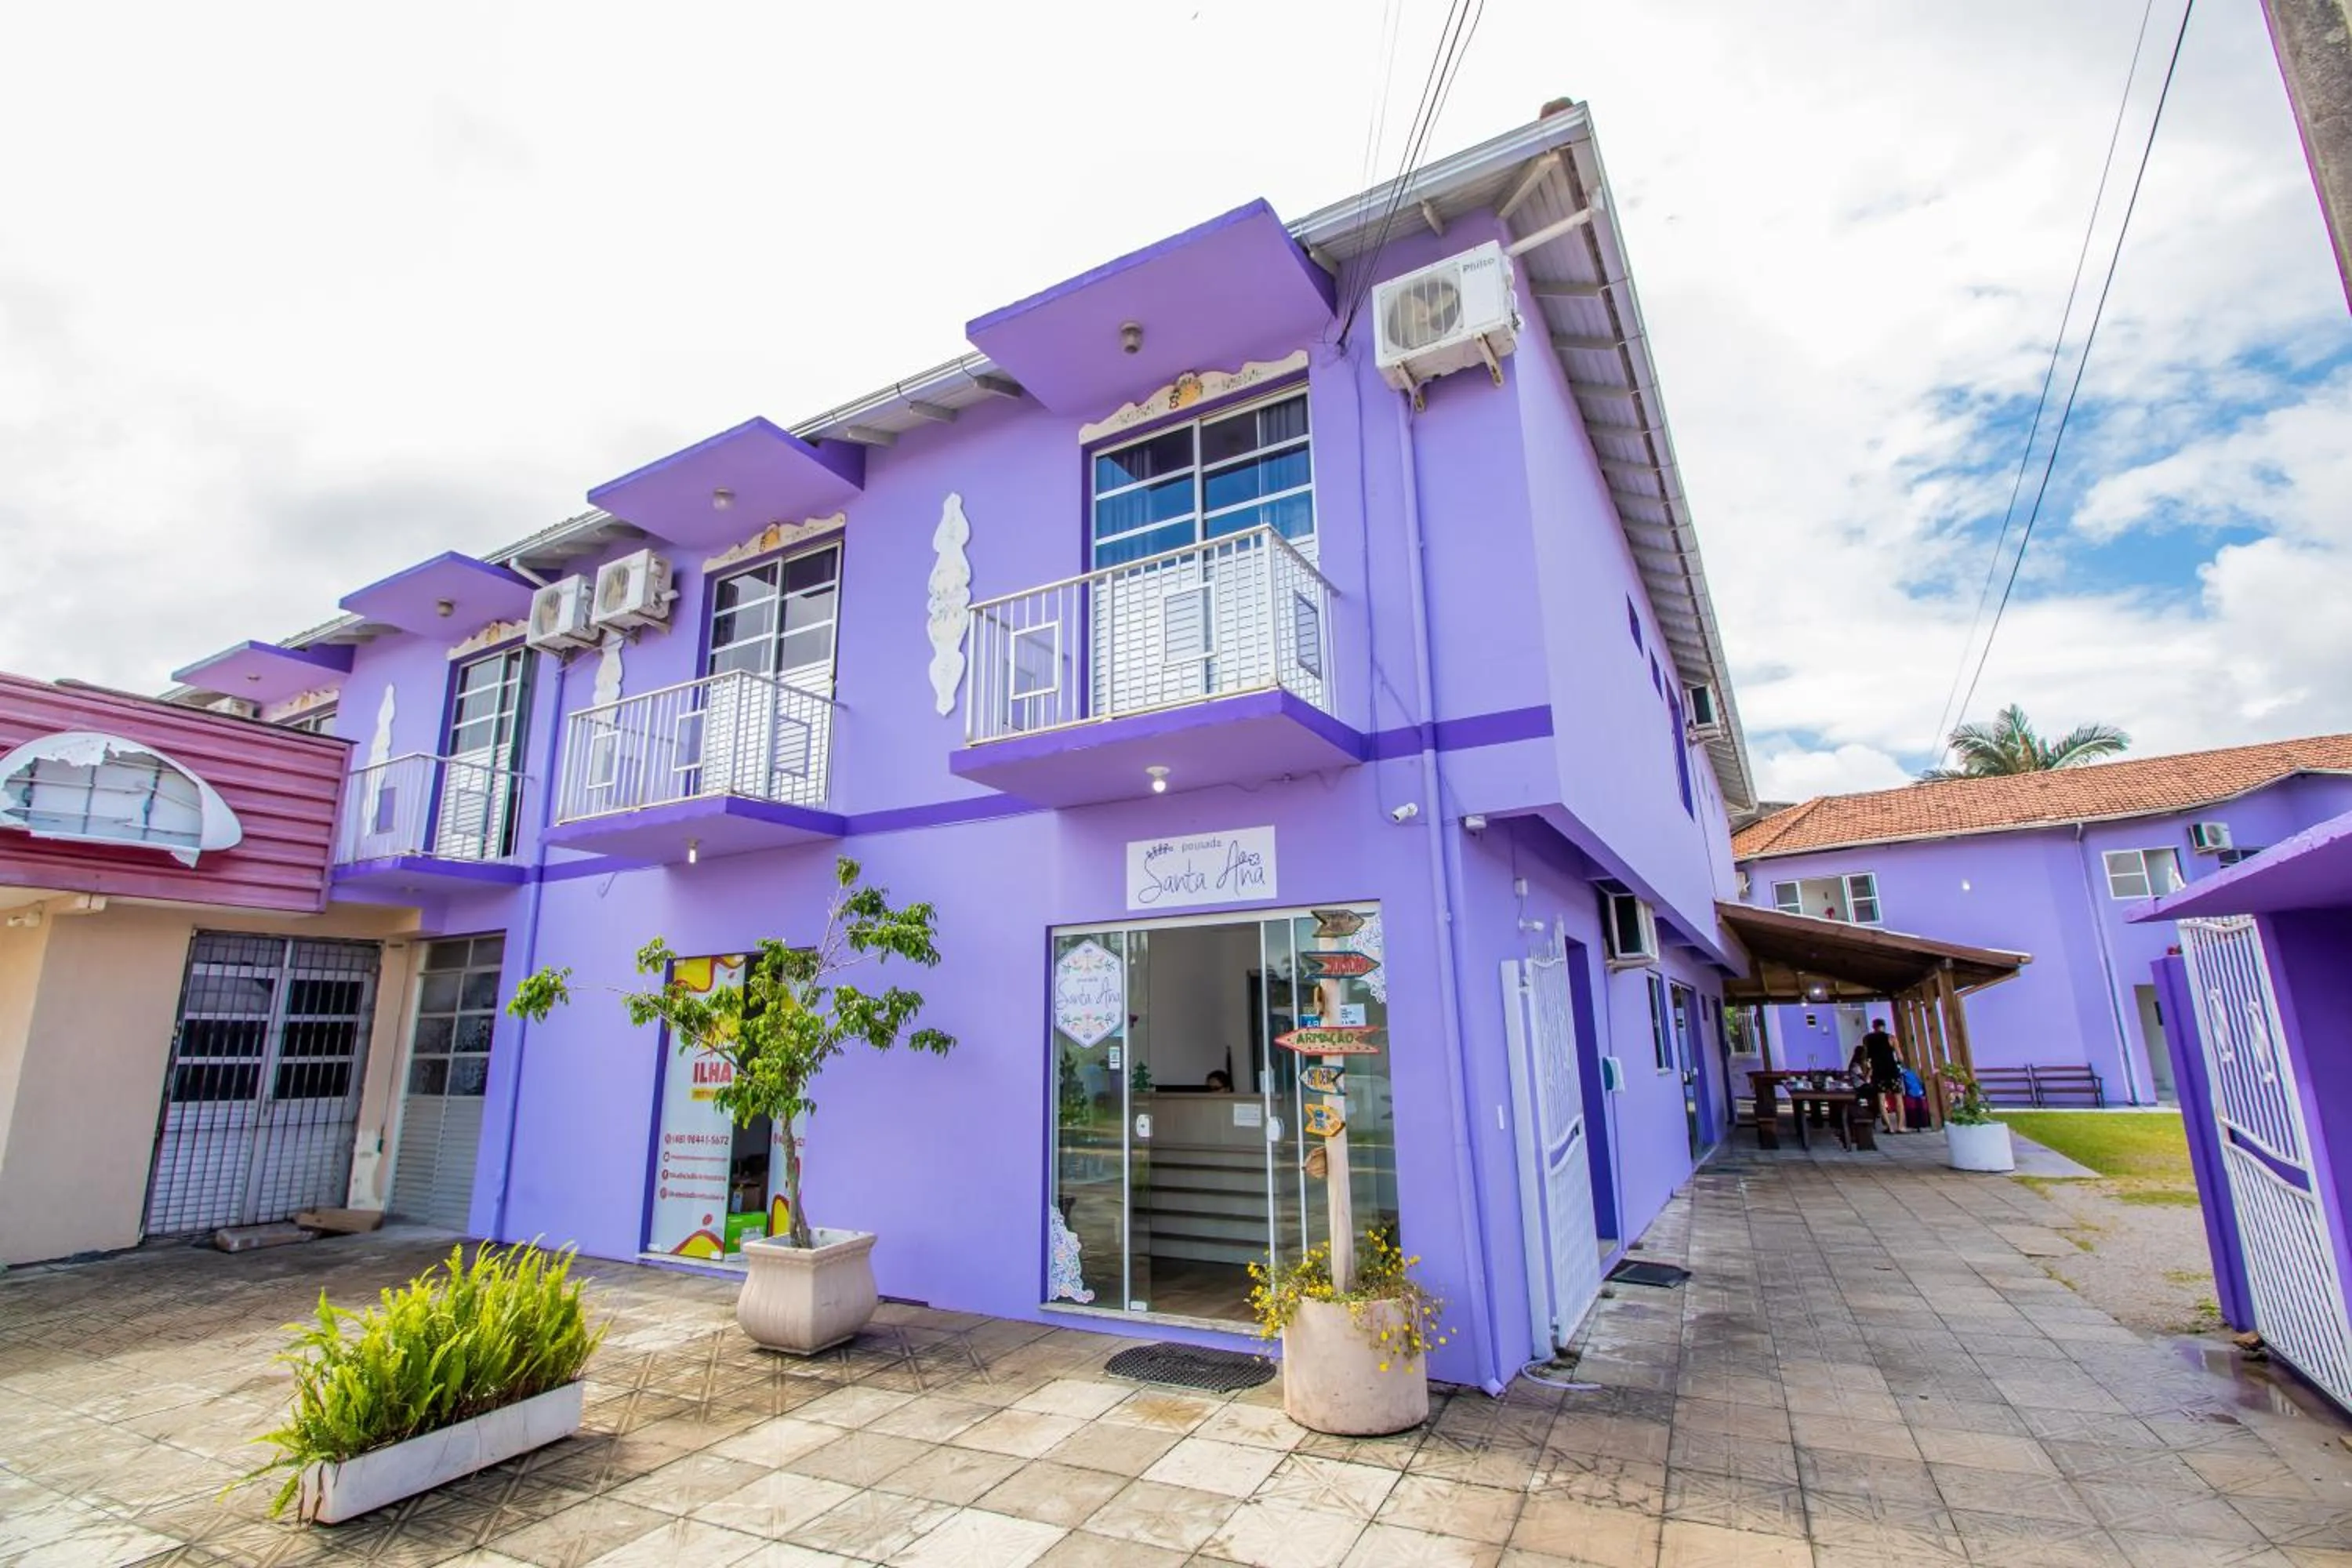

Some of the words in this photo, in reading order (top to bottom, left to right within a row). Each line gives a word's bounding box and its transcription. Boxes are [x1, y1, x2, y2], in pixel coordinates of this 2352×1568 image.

[1181, 836, 1222, 853] pousada
[1138, 856, 1207, 904] Santa
[1216, 840, 1266, 897] Ana
[693, 1062, 732, 1083] ILHA
